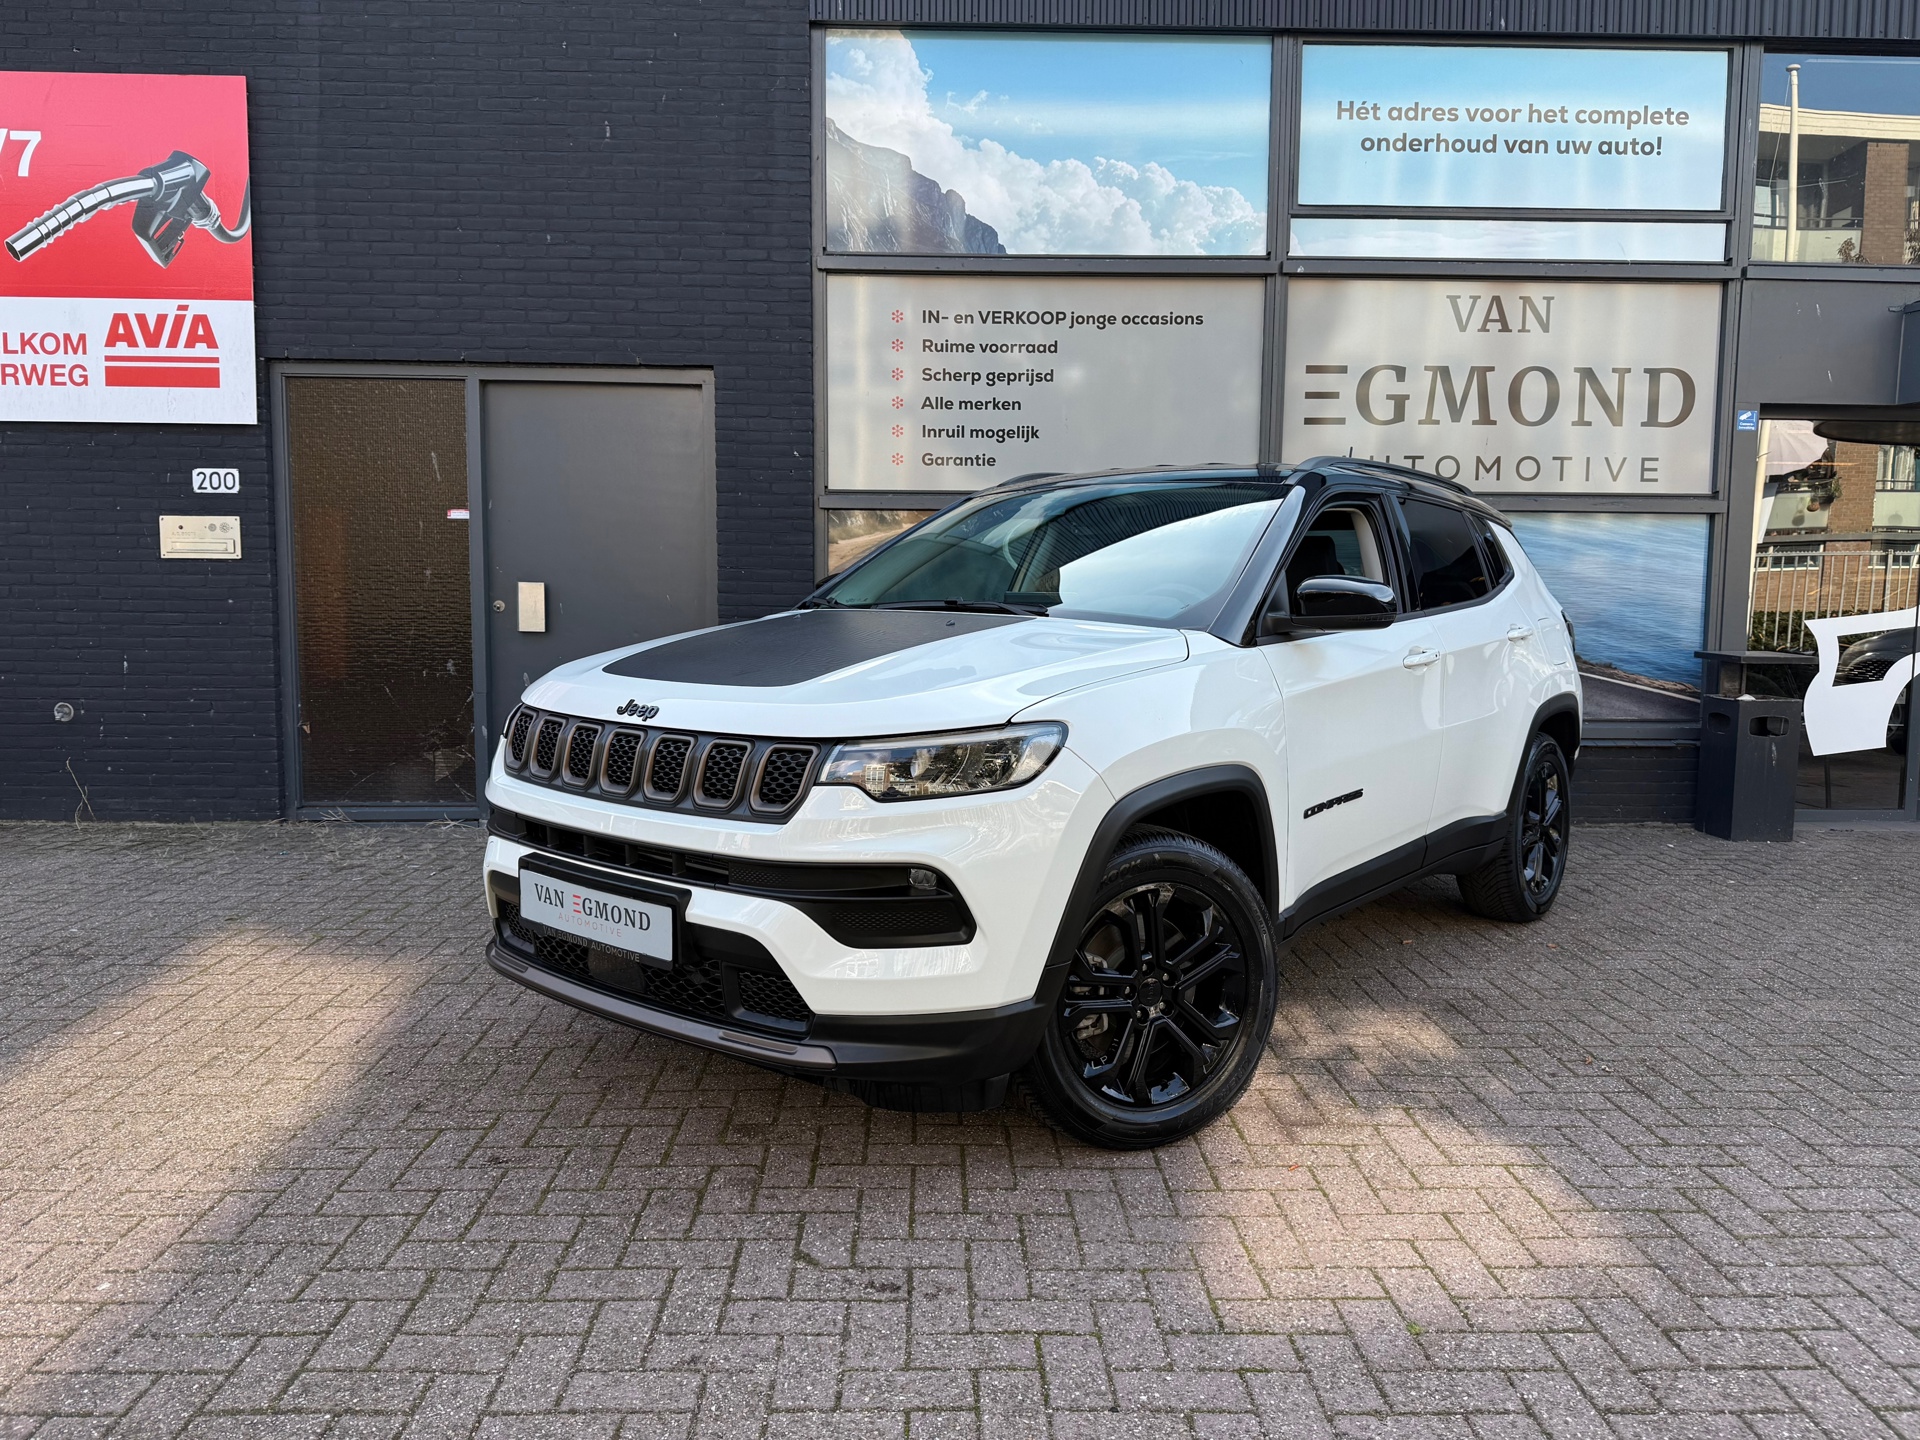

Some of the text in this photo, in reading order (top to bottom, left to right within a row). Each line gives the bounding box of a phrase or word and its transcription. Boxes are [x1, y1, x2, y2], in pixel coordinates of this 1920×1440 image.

[1336, 100, 1690, 130] Hét adres voor het complete
[1360, 132, 1663, 157] onderhoud van uw auto!
[921, 309, 1205, 330] IN- en VERKOOP jonge occasions
[1446, 294, 1555, 334] VAN
[2, 332, 88, 357] LKOM
[921, 338, 1059, 355] Ruime voorraad
[921, 367, 1054, 387] Scherp geprijsd
[920, 395, 1022, 412] Alle merken
[1303, 364, 1697, 429] EGMOND
[921, 424, 1040, 443] Inruil mogelijk
[921, 452, 997, 468] Garantie
[1342, 455, 1660, 484] TOMOTIVE
[195, 471, 237, 491] 200
[616, 698, 660, 722] Jeep
[534, 882, 651, 932] VAN EGMOND
[557, 911, 622, 938] AUTOMOTIVE
[543, 926, 640, 962] VAN EGMOND AUTOMOTIVE
